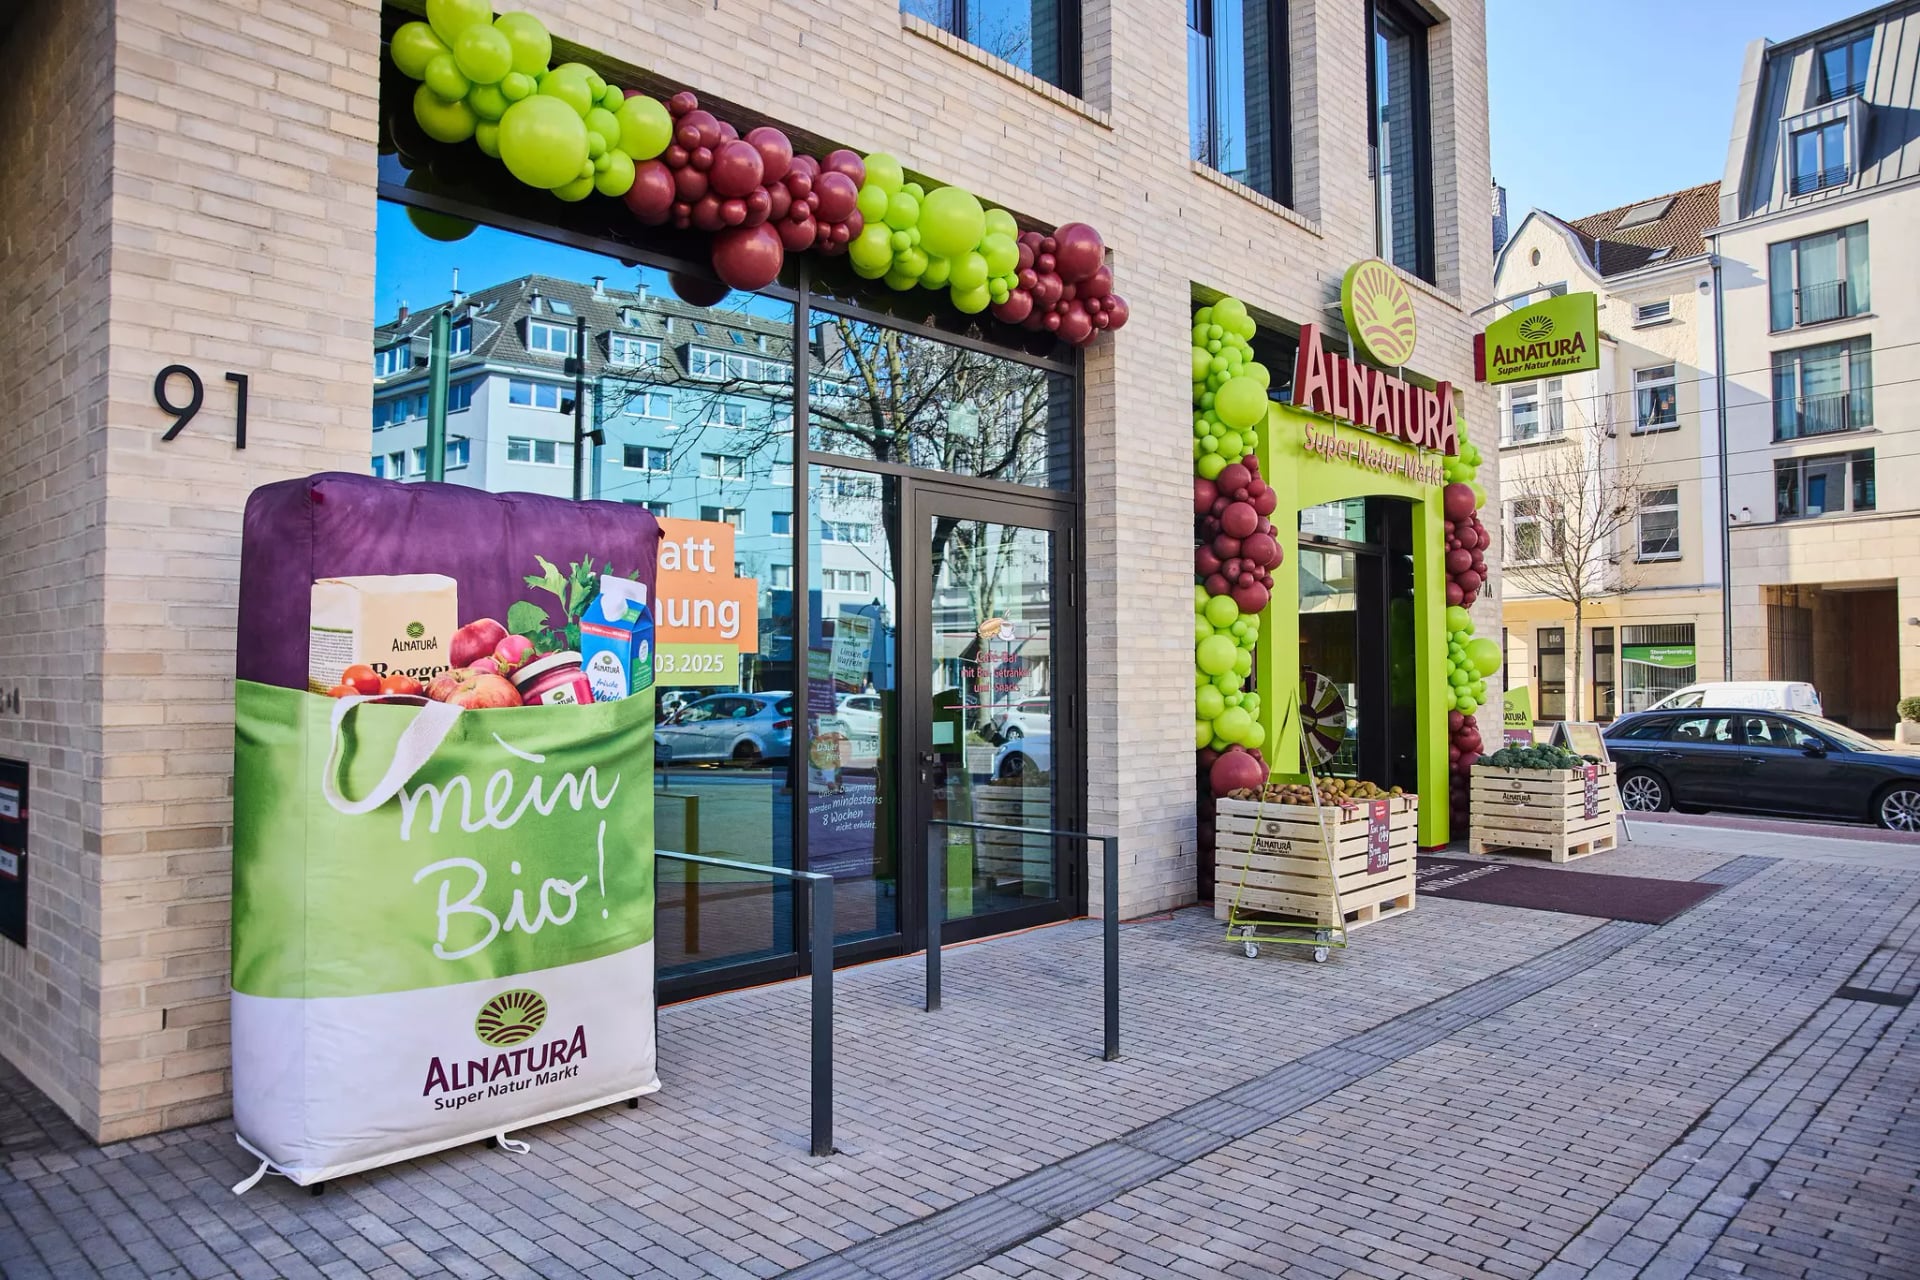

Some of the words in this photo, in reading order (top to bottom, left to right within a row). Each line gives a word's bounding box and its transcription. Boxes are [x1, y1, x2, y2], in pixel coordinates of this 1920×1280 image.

[1492, 331, 1586, 367] ALNATURA
[1497, 364, 1522, 376] Super
[1524, 361, 1549, 371] Natur
[1552, 355, 1581, 367] Markt
[1294, 323, 1460, 457] ALNATURA
[154, 364, 248, 449] 91
[1304, 422, 1354, 463] Super
[1357, 438, 1400, 475] Natur
[1403, 452, 1445, 488] Markt
[659, 536, 716, 573] att
[392, 636, 438, 652] ALNATURA
[655, 653, 724, 673] 03.2025
[1503, 711, 1527, 721] ATURA
[400, 732, 620, 841] mein
[808, 802, 832, 815] werden
[832, 793, 884, 809] mindestens
[822, 813, 829, 826] 8
[830, 808, 864, 824] Wochen
[835, 822, 853, 832] nicht
[1255, 837, 1293, 851] ALNATURA
[423, 1025, 588, 1096] ALNATURA
[434, 1085, 484, 1110] Super
[487, 1077, 533, 1098] Natur
[535, 1064, 579, 1086] Markt
